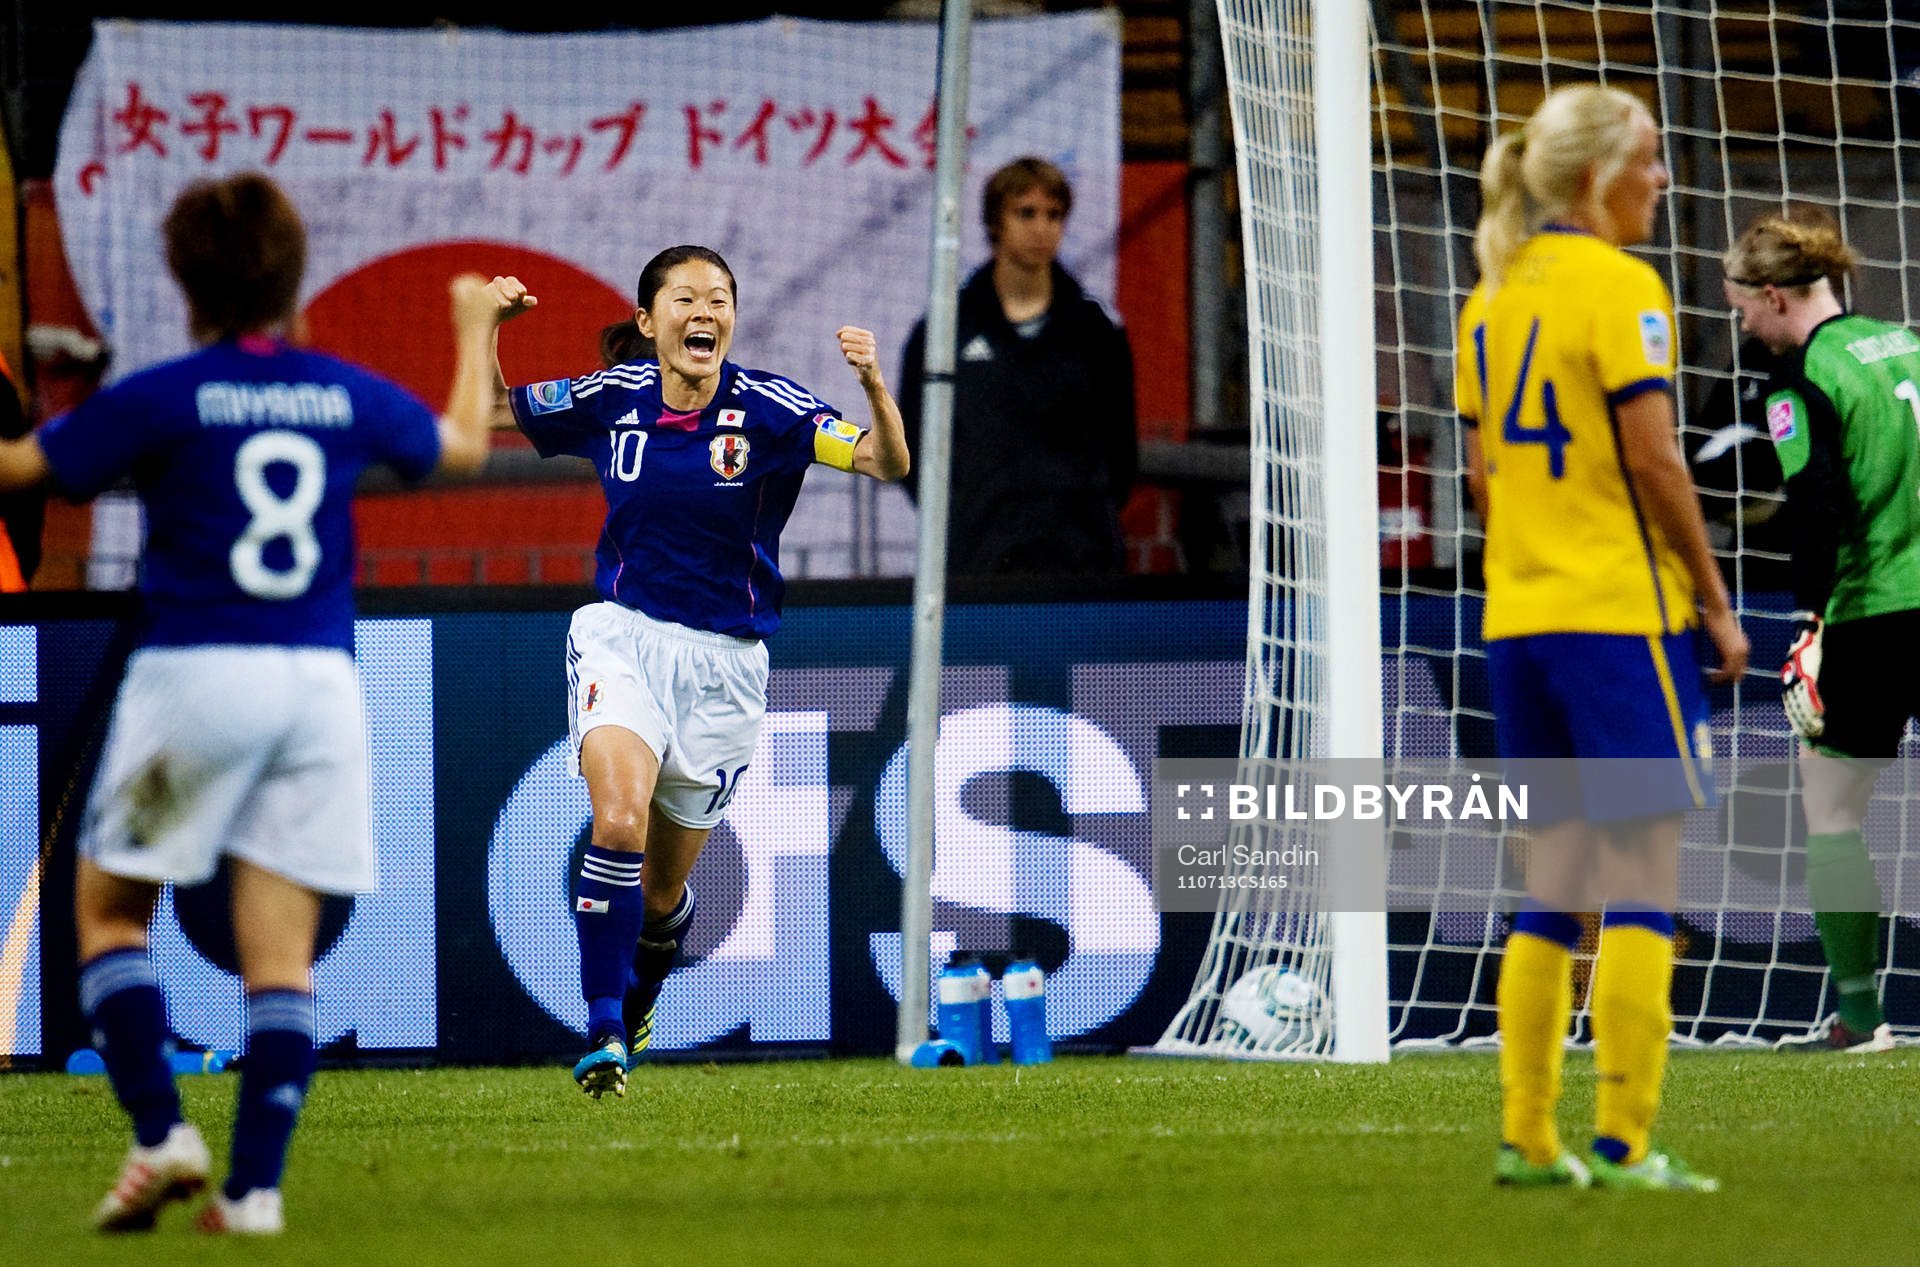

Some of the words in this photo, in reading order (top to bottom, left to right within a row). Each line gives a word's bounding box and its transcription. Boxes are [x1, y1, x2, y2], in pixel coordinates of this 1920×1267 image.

[610, 429, 648, 482] 10
[1472, 315, 1573, 479] 14
[229, 430, 327, 600] 8
